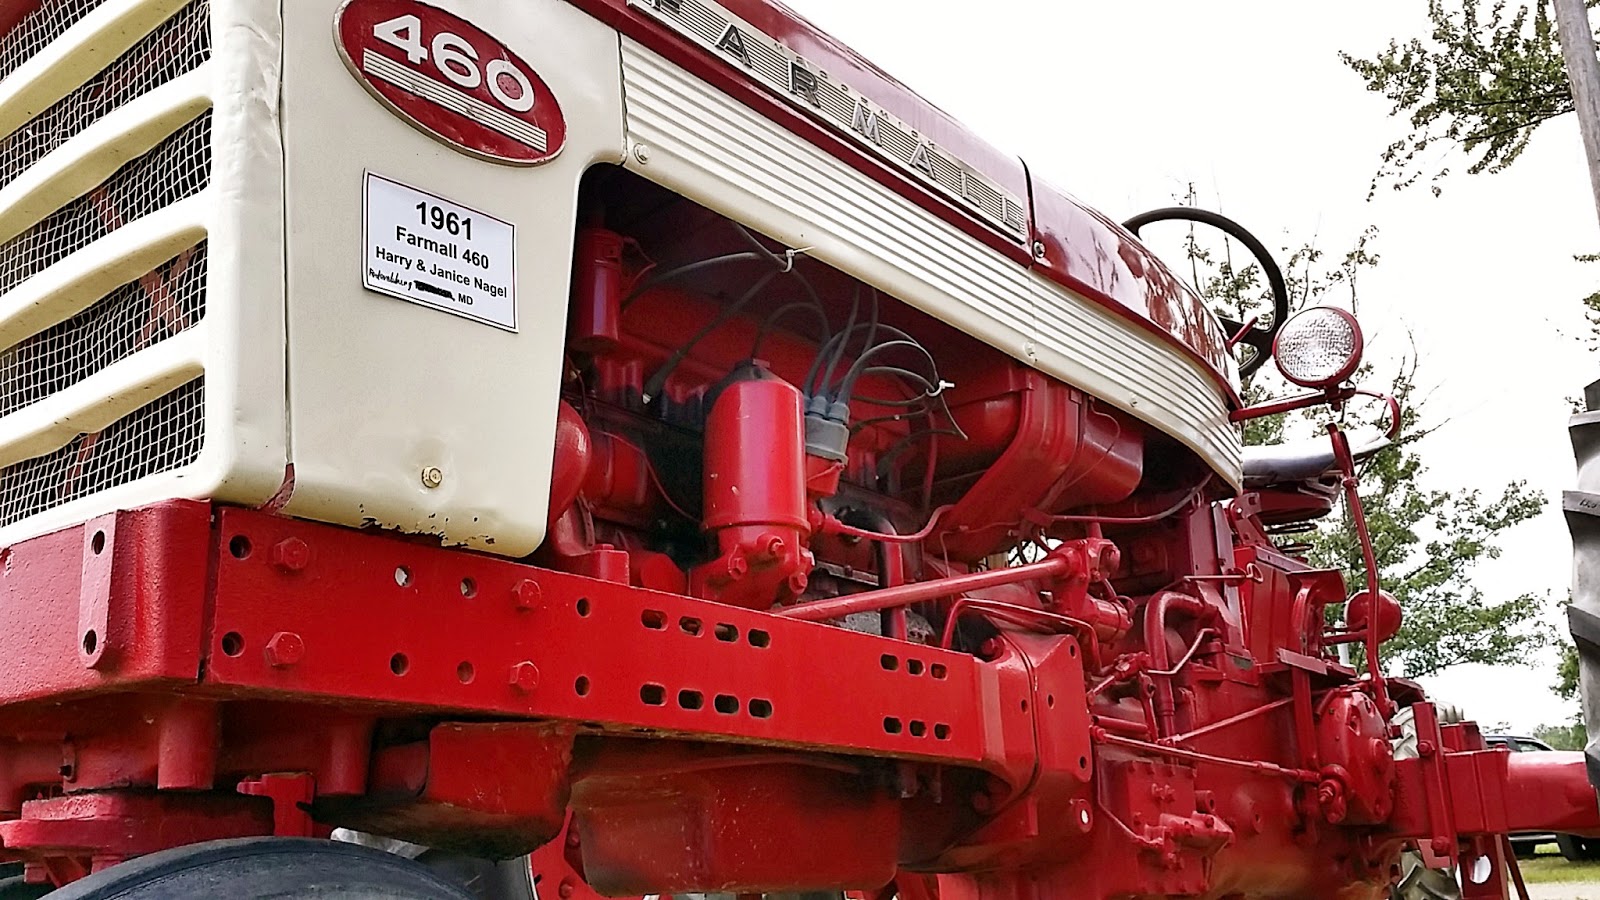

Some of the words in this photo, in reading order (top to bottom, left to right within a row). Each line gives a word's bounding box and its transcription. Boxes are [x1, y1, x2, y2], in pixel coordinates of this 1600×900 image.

[373, 14, 535, 112] 460
[415, 201, 472, 241] 1961
[396, 225, 457, 260] Farmall
[462, 249, 489, 270] 460
[375, 246, 412, 270] Harry
[416, 259, 427, 273] &
[430, 264, 470, 286] Janice
[474, 276, 507, 298] Nagel
[458, 293, 474, 306] MD
